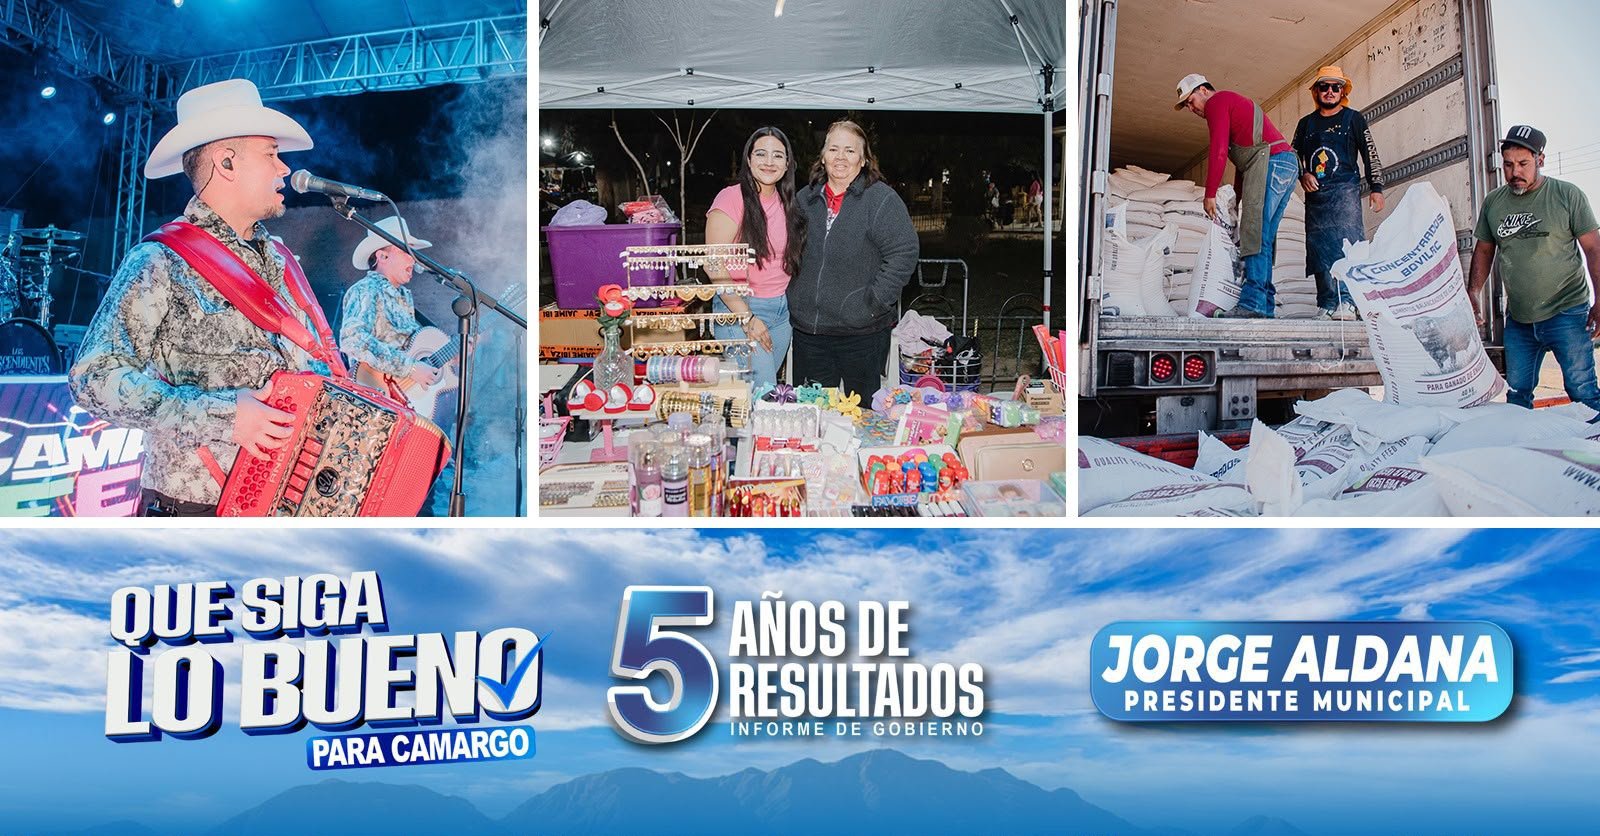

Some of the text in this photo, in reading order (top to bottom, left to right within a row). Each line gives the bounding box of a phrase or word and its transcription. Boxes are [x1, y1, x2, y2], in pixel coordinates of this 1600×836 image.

[1503, 212, 1533, 228] NIKE
[1370, 213, 1445, 275] CONCENTRADOS
[1400, 240, 1443, 277] BOVILAC
[1427, 383, 1443, 391] PARA
[1444, 376, 1467, 389] GANADO
[0, 428, 144, 476] AM
[1381, 447, 1398, 461] FEED
[1094, 456, 1129, 467] QUALITY
